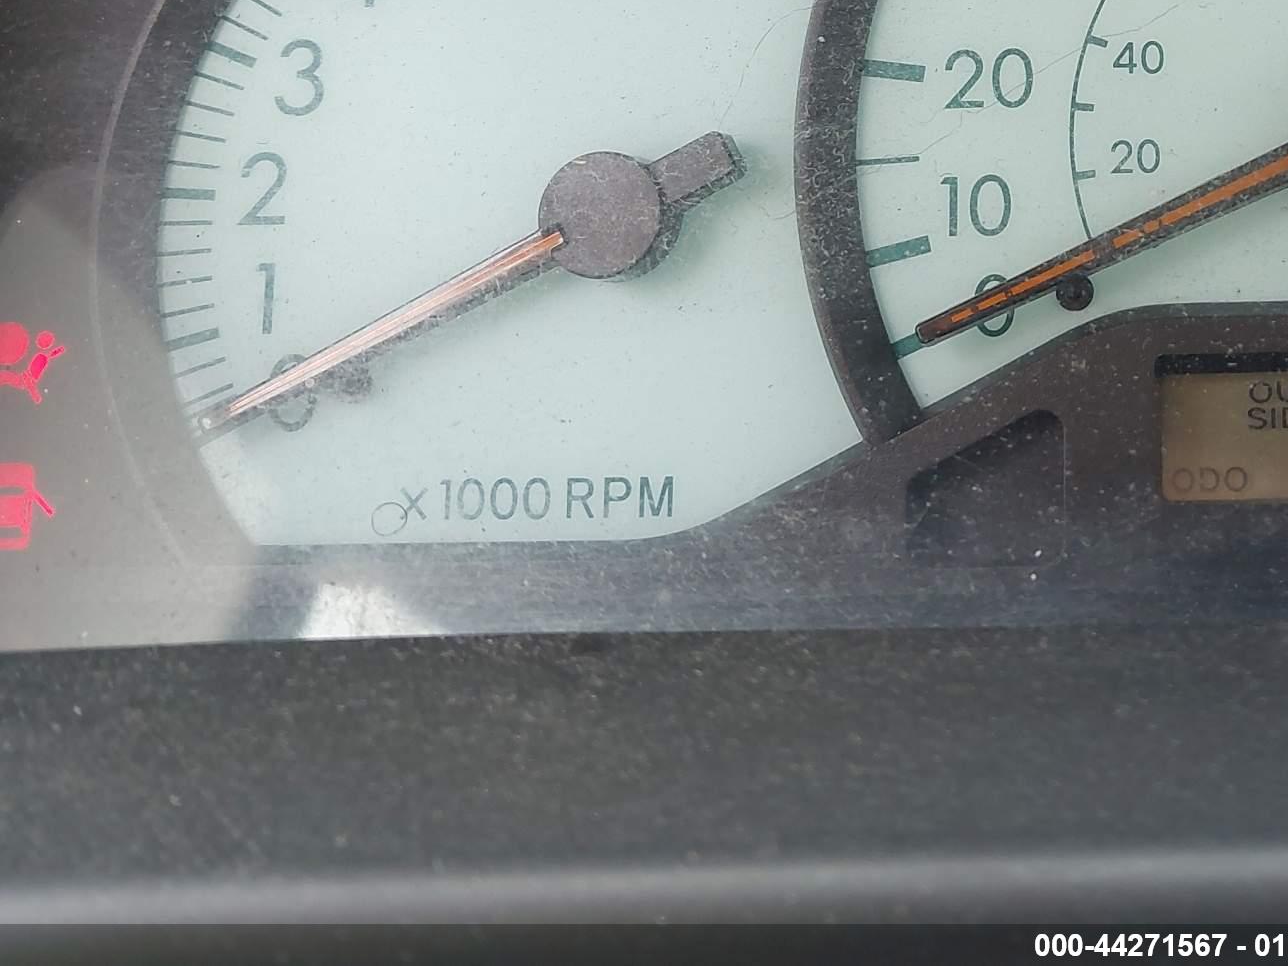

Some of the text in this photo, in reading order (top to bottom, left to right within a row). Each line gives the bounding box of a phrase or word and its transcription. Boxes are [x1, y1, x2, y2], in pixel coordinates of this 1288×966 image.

[274, 39, 324, 115] 3
[943, 48, 1034, 109] 20
[1112, 40, 1165, 75] 40
[1110, 139, 1161, 174] 20
[238, 152, 287, 225] 2
[939, 174, 1012, 236] 10
[257, 262, 274, 335] 1
[566, 476, 674, 518] RPM
[1172, 467, 1248, 492] ODO
